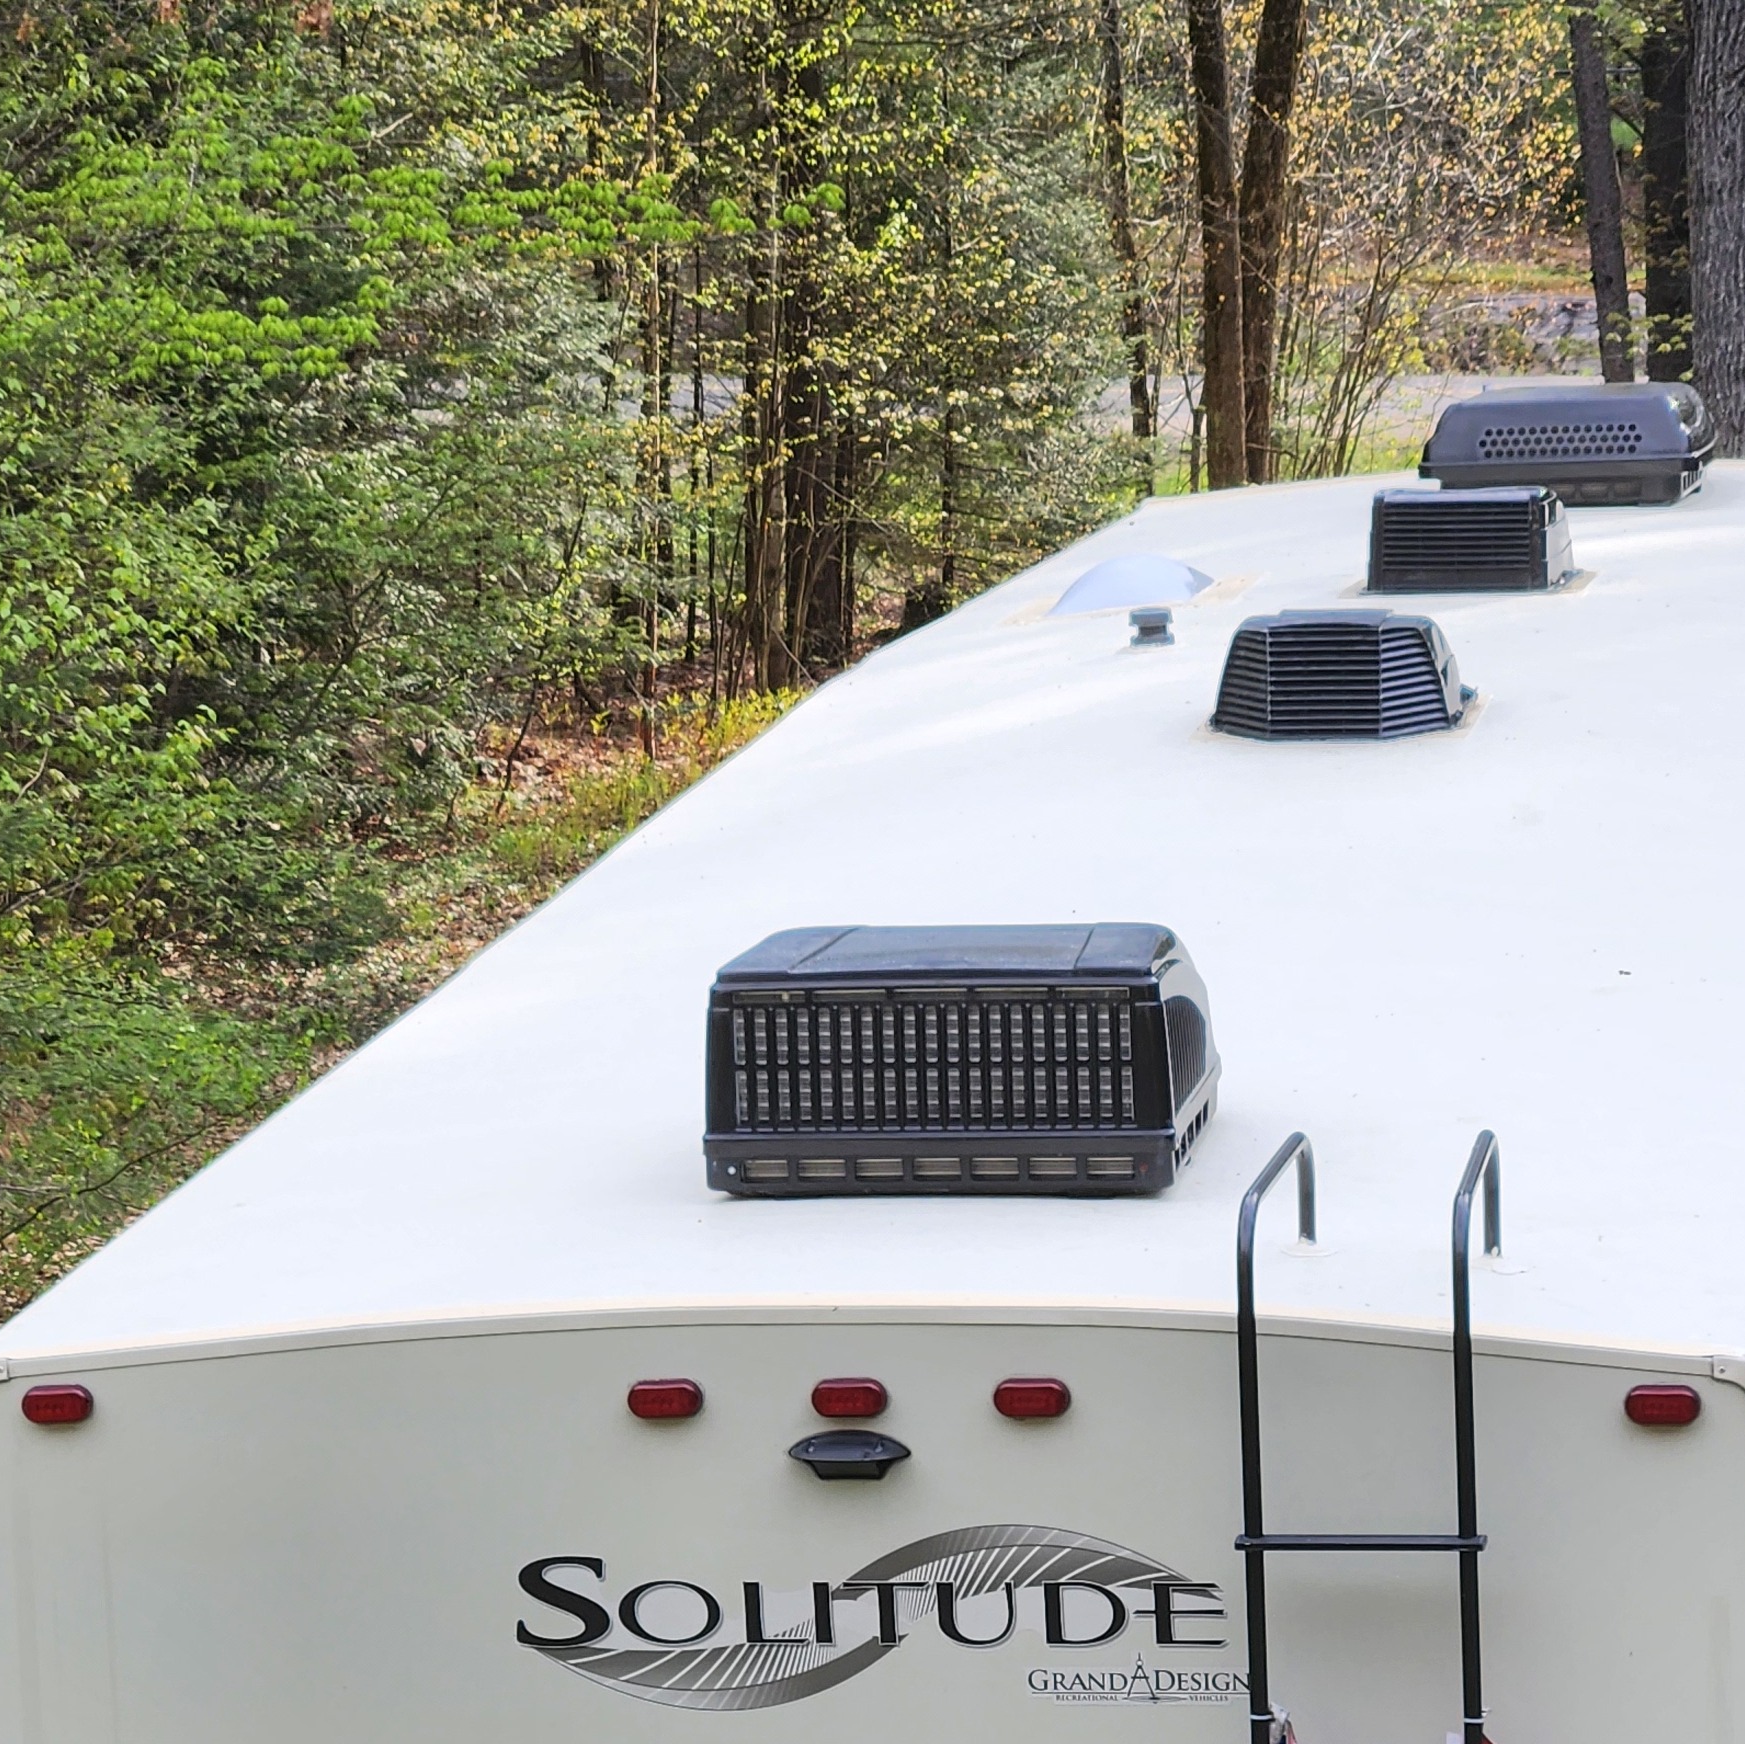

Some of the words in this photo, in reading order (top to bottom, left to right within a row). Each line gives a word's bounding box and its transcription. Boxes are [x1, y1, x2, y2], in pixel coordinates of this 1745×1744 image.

[516, 1555, 1227, 1648] SOLITUDE
[1055, 1694, 1119, 1702] RECREATIONAL
[1188, 1694, 1229, 1702] VEHICLES
